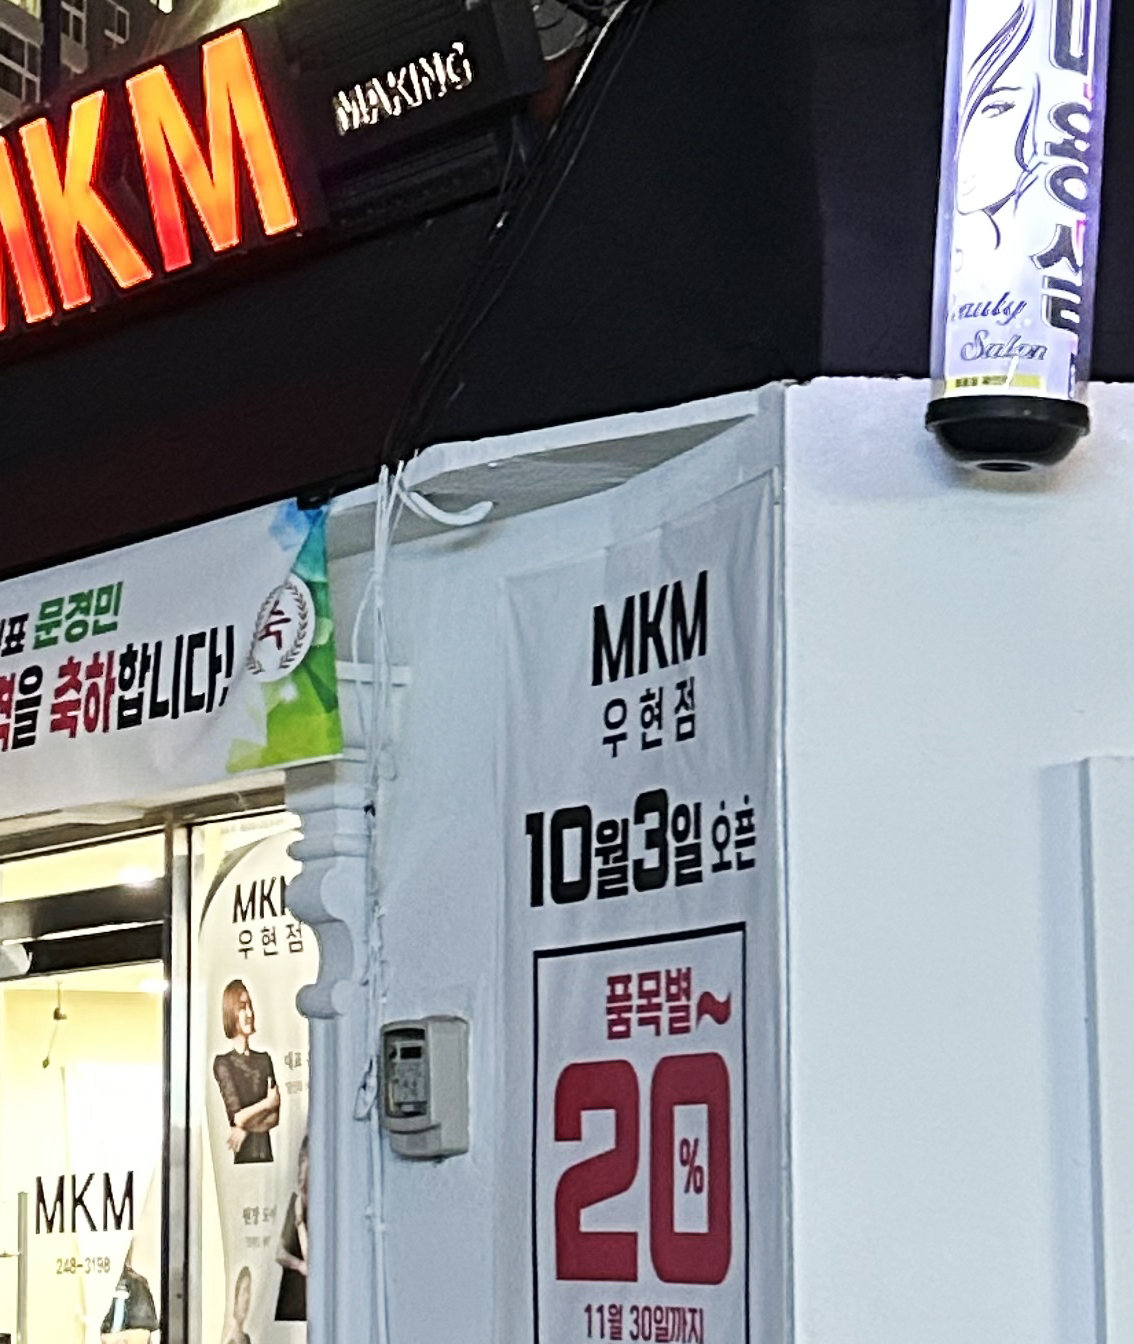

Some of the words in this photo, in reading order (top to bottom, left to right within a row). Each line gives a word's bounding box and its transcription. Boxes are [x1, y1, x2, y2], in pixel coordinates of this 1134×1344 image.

[333, 41, 473, 136] MAKING
[960, 329, 1048, 362] Salon
[32, 581, 124, 651] 문경민
[591, 570, 709, 686] MKM
[48, 625, 235, 740] 축하합니다!
[602, 676, 697, 758] 우현점
[525, 788, 703, 907] 10월3일
[711, 795, 756, 873] 오픈
[237, 923, 304, 960] 우현점
[35, 1170, 135, 1235] MKM
[583, 1303, 624, 1342] 11월
[629, 1304, 705, 1344] 30일까지
